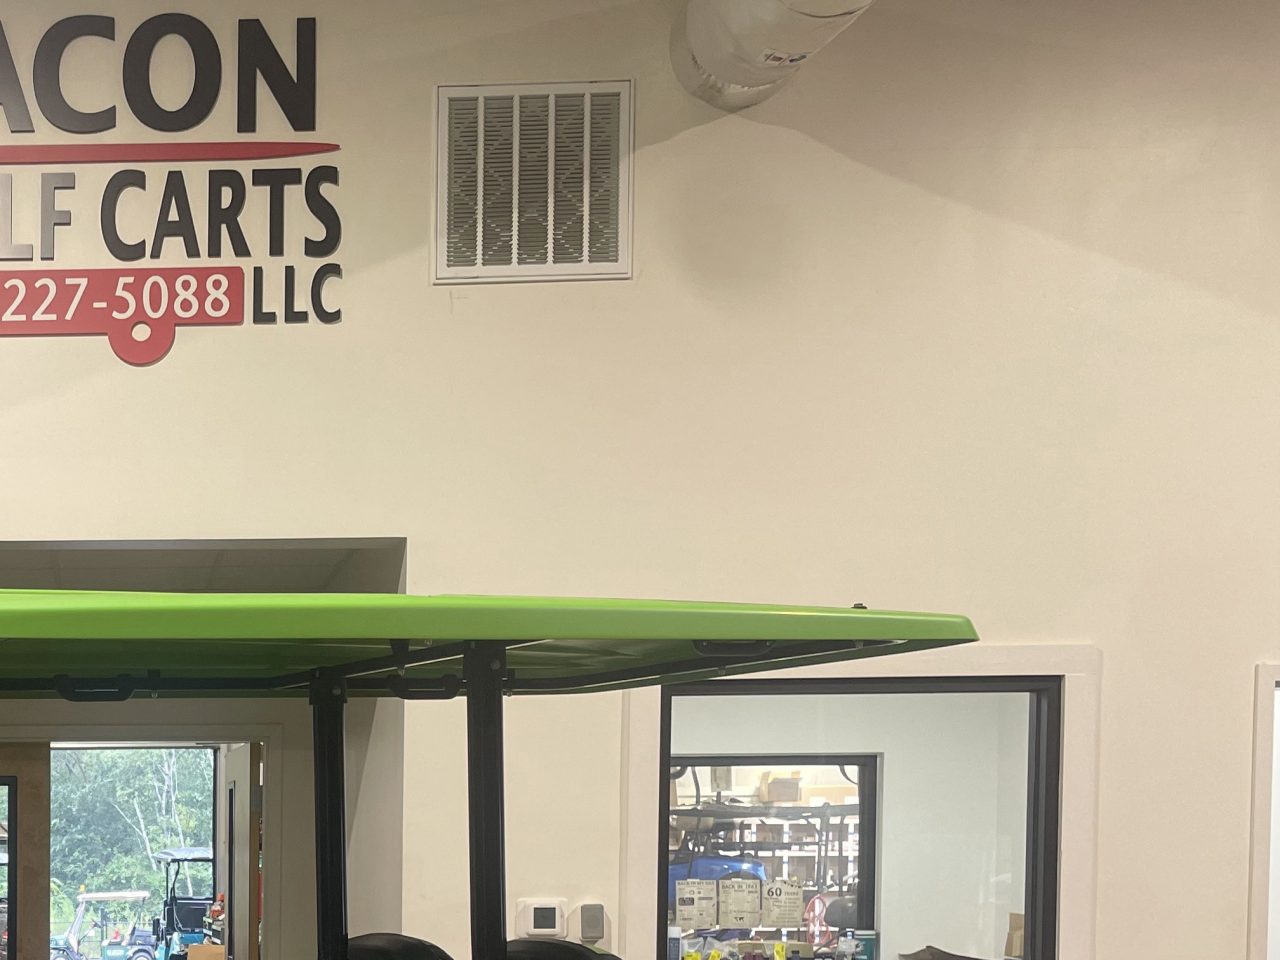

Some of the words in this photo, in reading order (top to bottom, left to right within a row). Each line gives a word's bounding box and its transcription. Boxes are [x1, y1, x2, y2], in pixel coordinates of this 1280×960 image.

[100, 166, 342, 261] CARTS
[252, 263, 342, 325] LLC
[767, 887, 782, 897] 60
